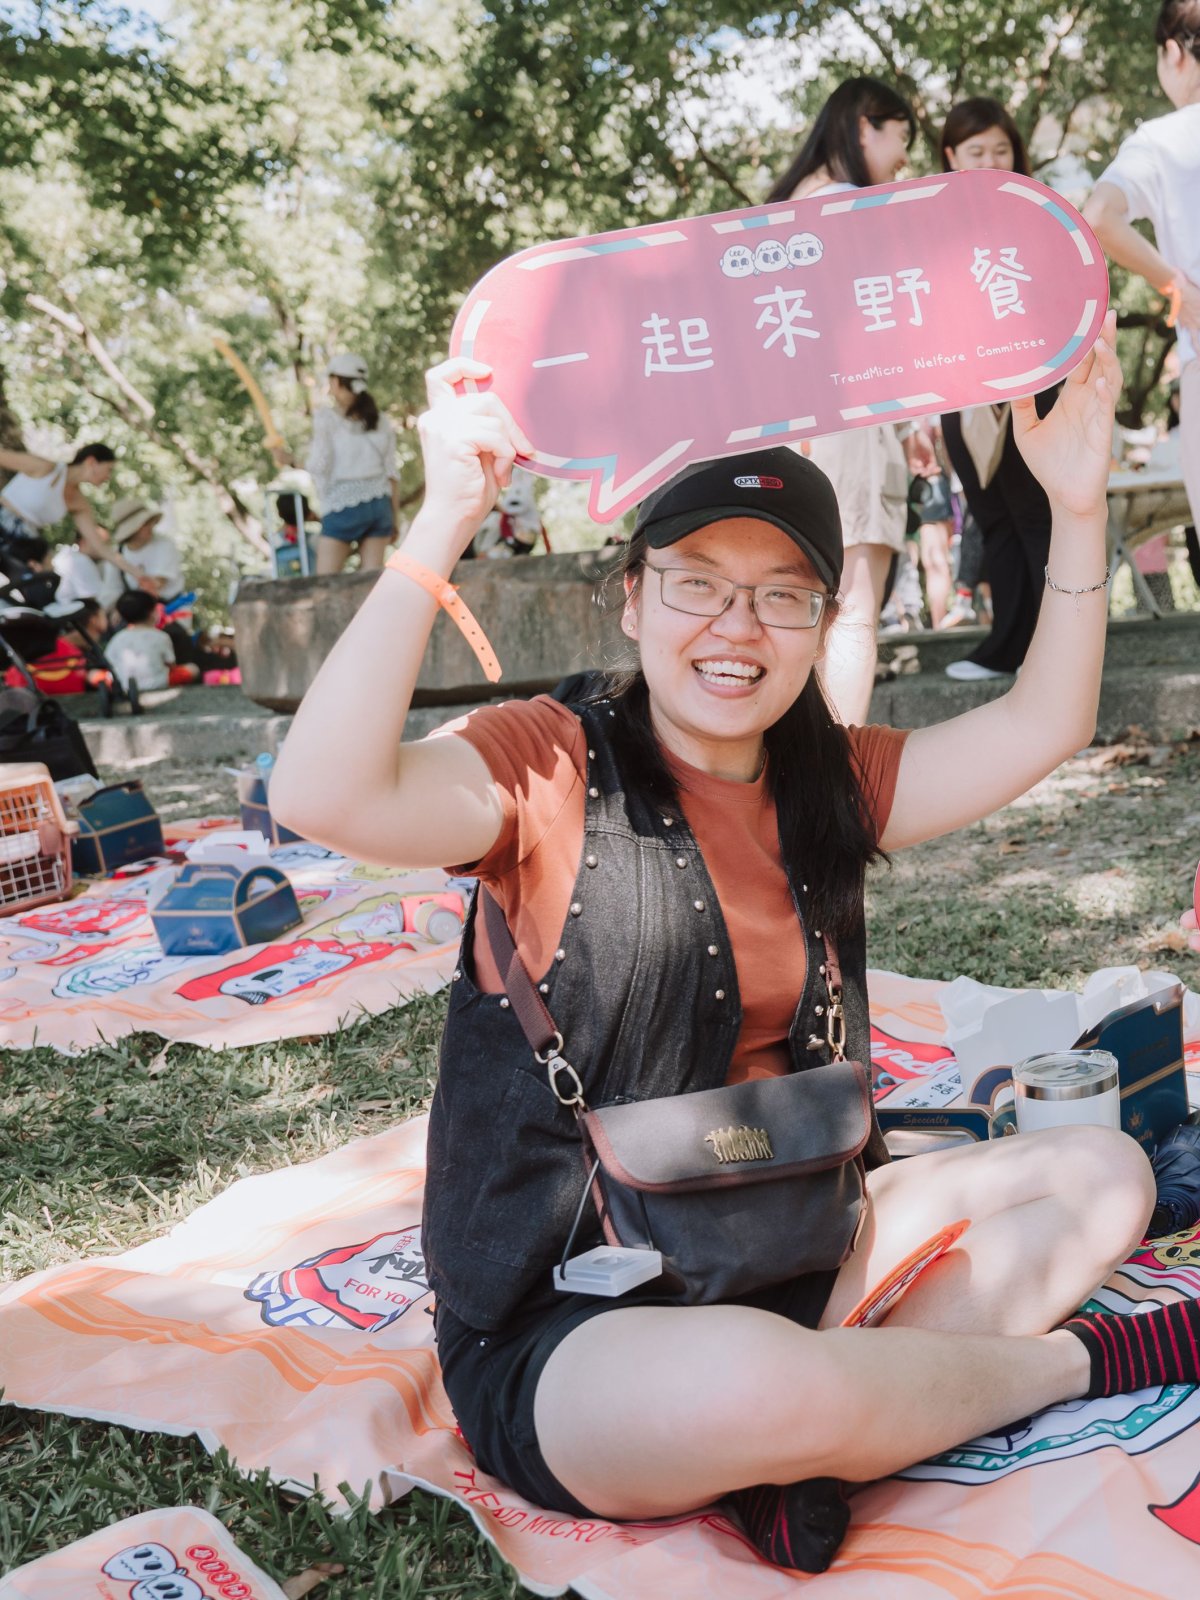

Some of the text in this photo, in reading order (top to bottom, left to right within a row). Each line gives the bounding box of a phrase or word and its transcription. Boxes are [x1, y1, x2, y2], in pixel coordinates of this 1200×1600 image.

[531, 246, 1032, 378] 一起來野餐
[830, 337, 1046, 386] TrendMicro Welfare Committee
[343, 1277, 382, 1299] FOR
[934, 1453, 1019, 1469] WEL
[520, 1515, 612, 1543] MICRO
